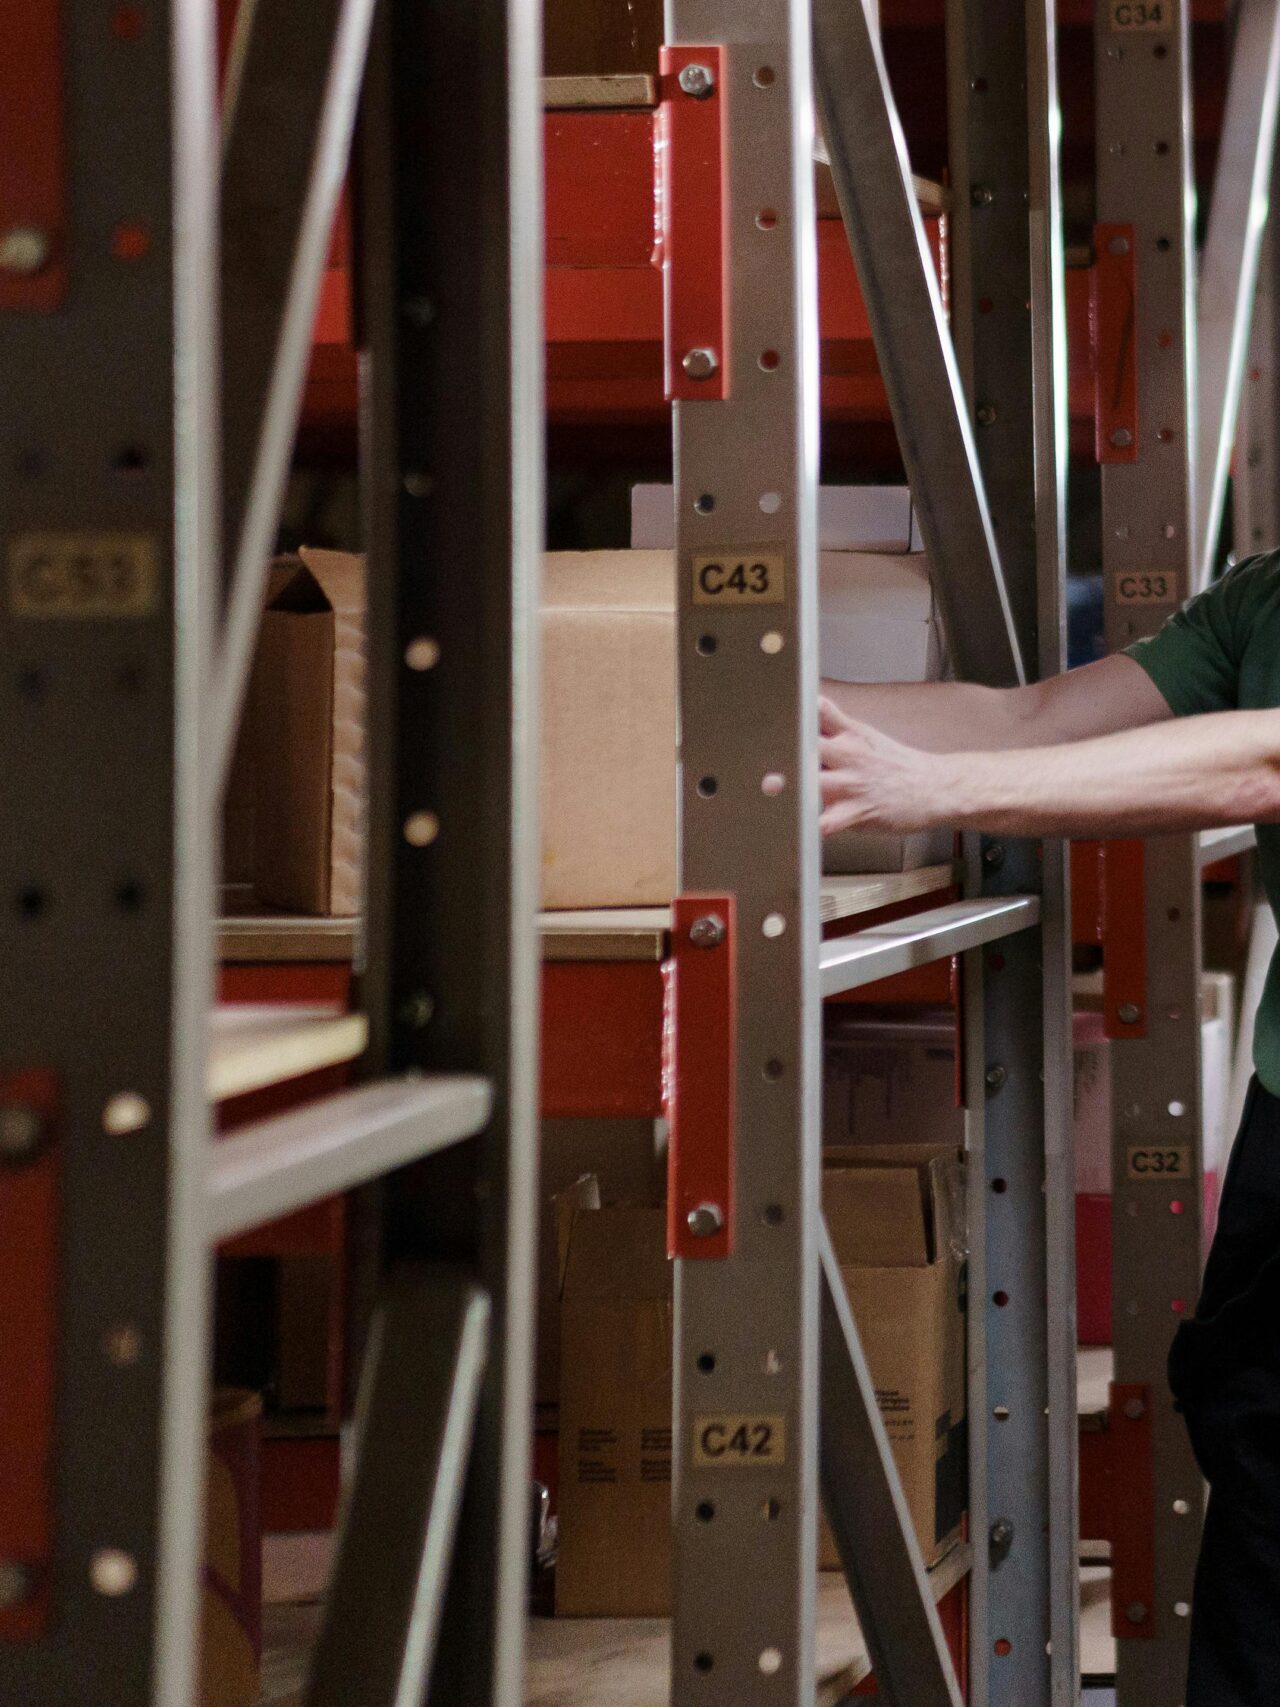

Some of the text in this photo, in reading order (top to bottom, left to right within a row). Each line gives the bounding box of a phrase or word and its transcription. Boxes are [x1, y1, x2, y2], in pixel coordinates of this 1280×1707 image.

[1114, 4, 1162, 26] C34
[699, 563, 769, 595] C43
[1119, 577, 1168, 598] C33
[1132, 1152, 1180, 1173] C32
[701, 1424, 773, 1457] C42
